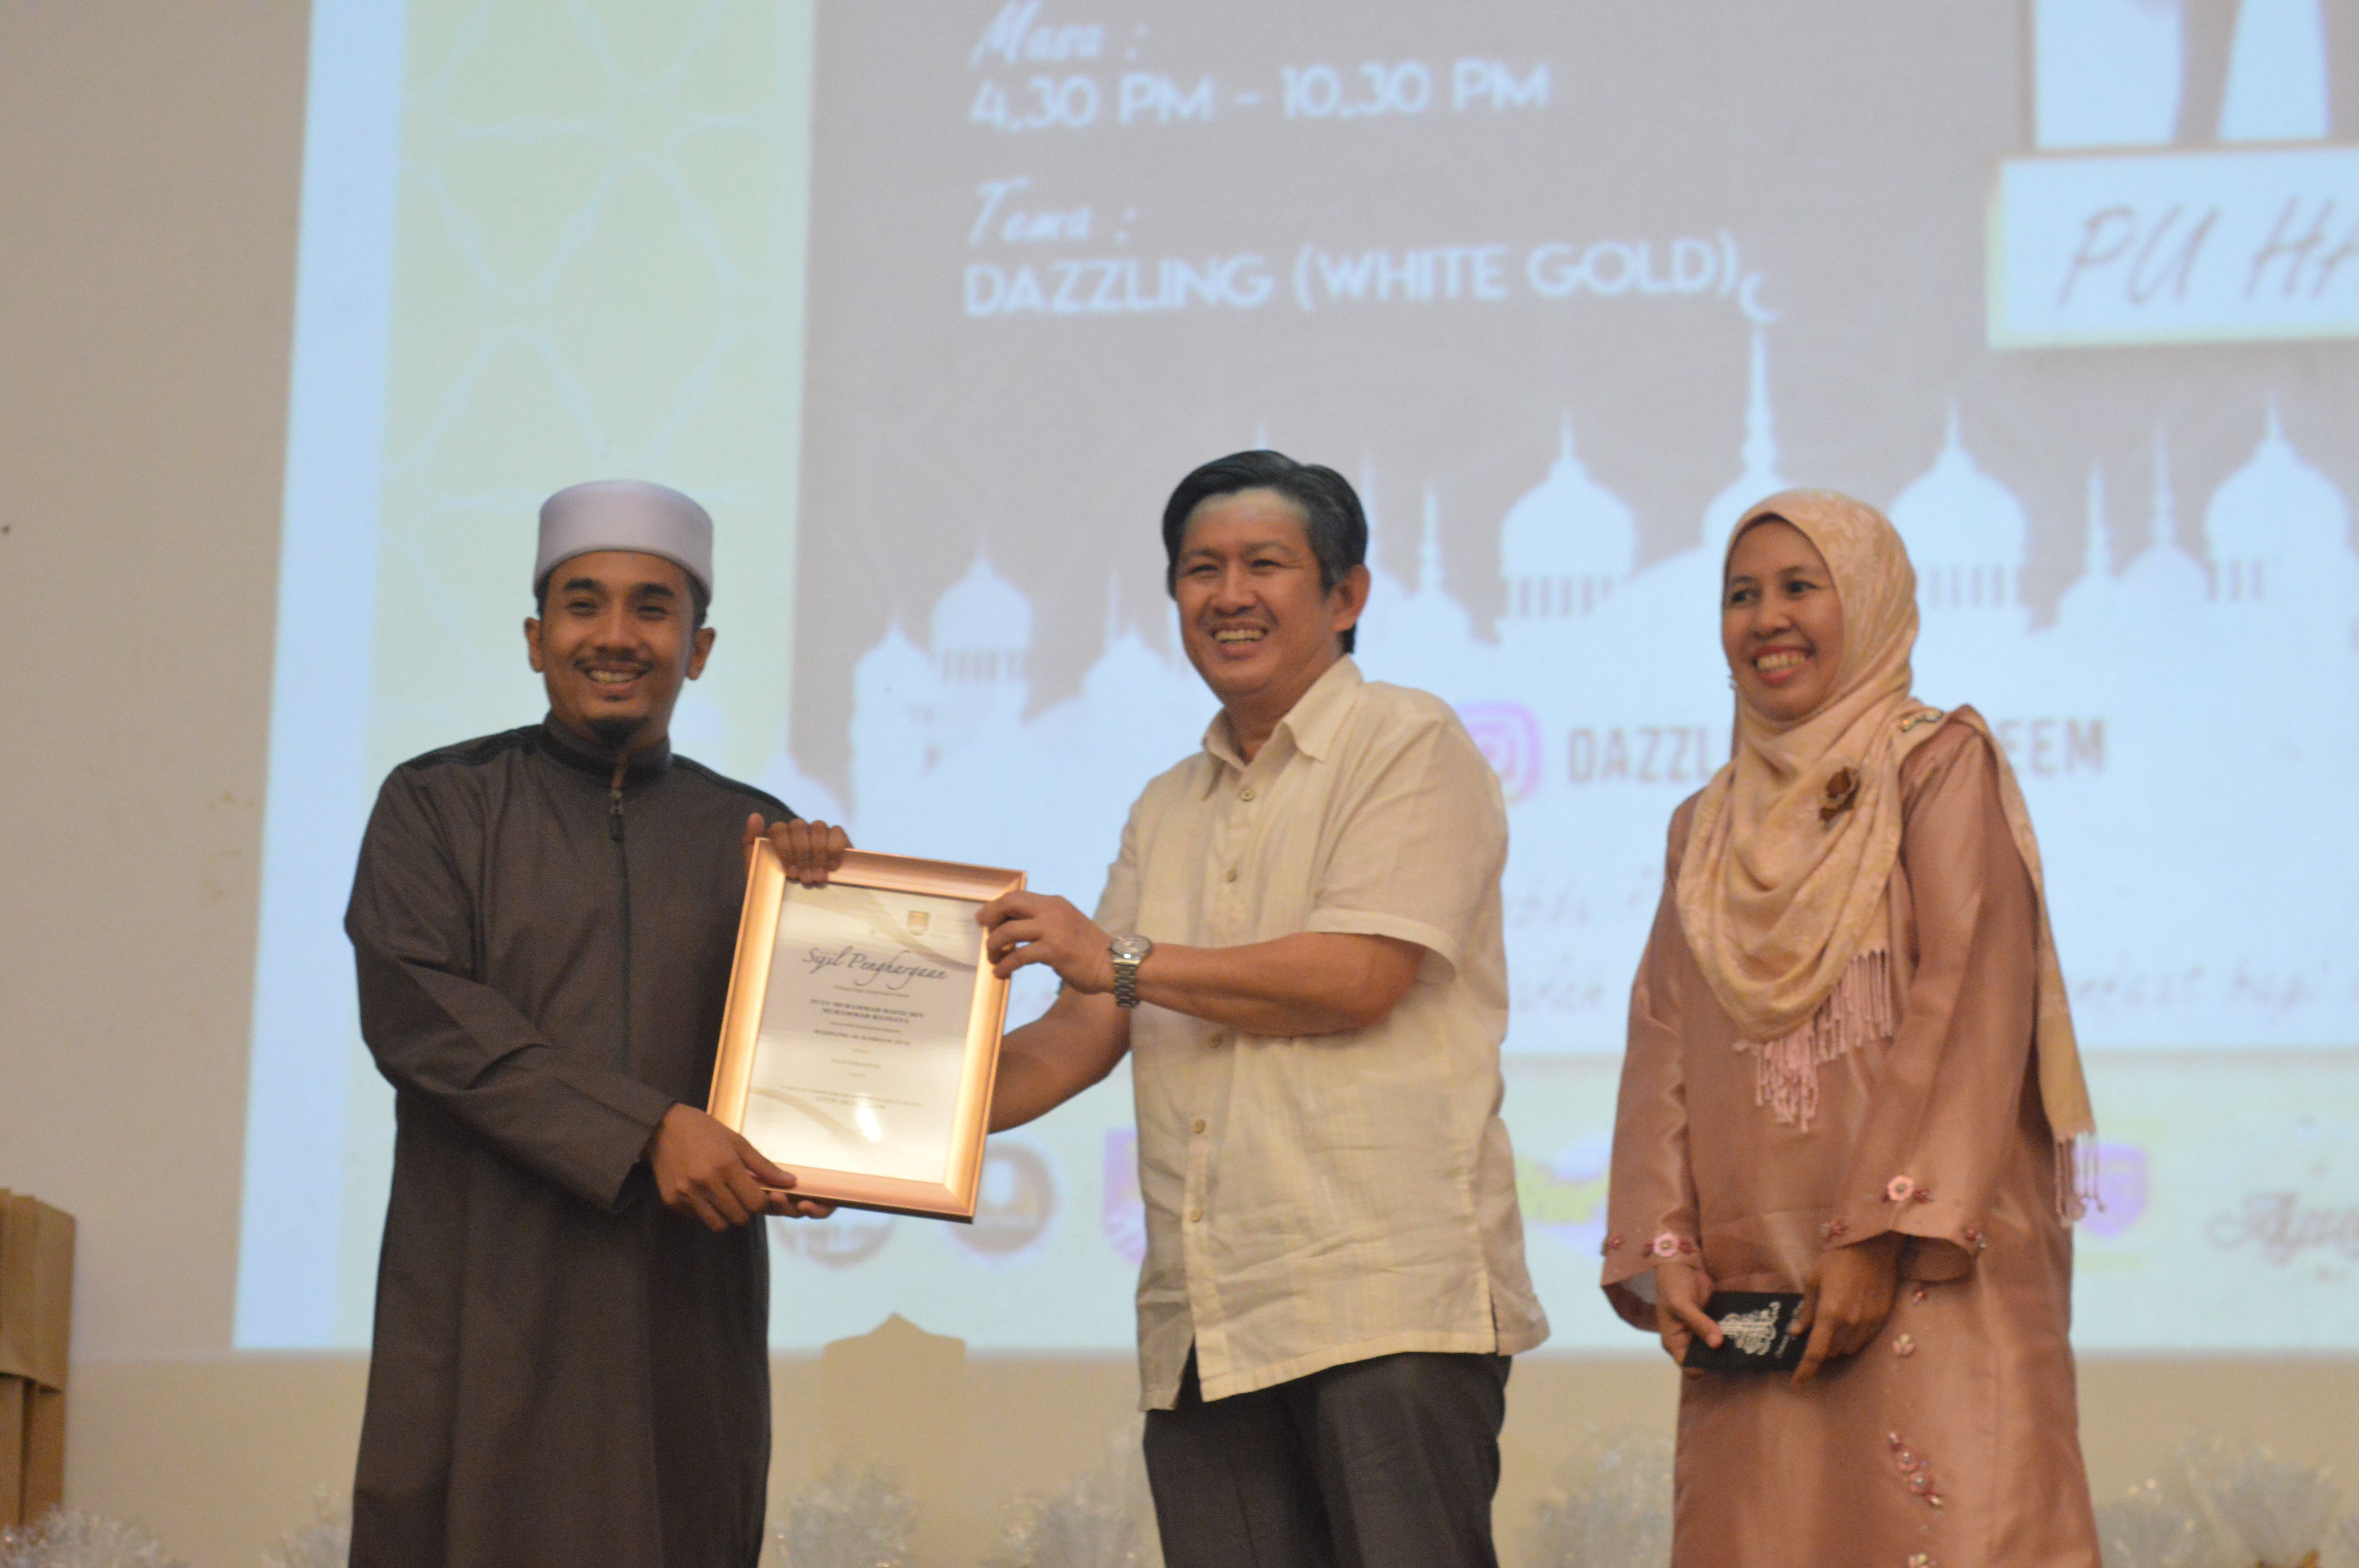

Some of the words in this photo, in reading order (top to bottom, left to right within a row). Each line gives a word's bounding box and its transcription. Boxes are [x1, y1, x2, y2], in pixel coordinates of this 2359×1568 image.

[969, 74, 1101, 132] 4.30
[1119, 72, 1214, 123] PM
[1281, 61, 1432, 118] 10.30
[1453, 58, 1550, 111] PM
[969, 176, 1092, 244] Tema
[965, 254, 1275, 316] DAZZLING
[1294, 245, 1507, 309] (WHITE
[1525, 231, 1740, 300] GOLD)
[2057, 202, 2223, 307] PU
[802, 946, 853, 974] Sijil
